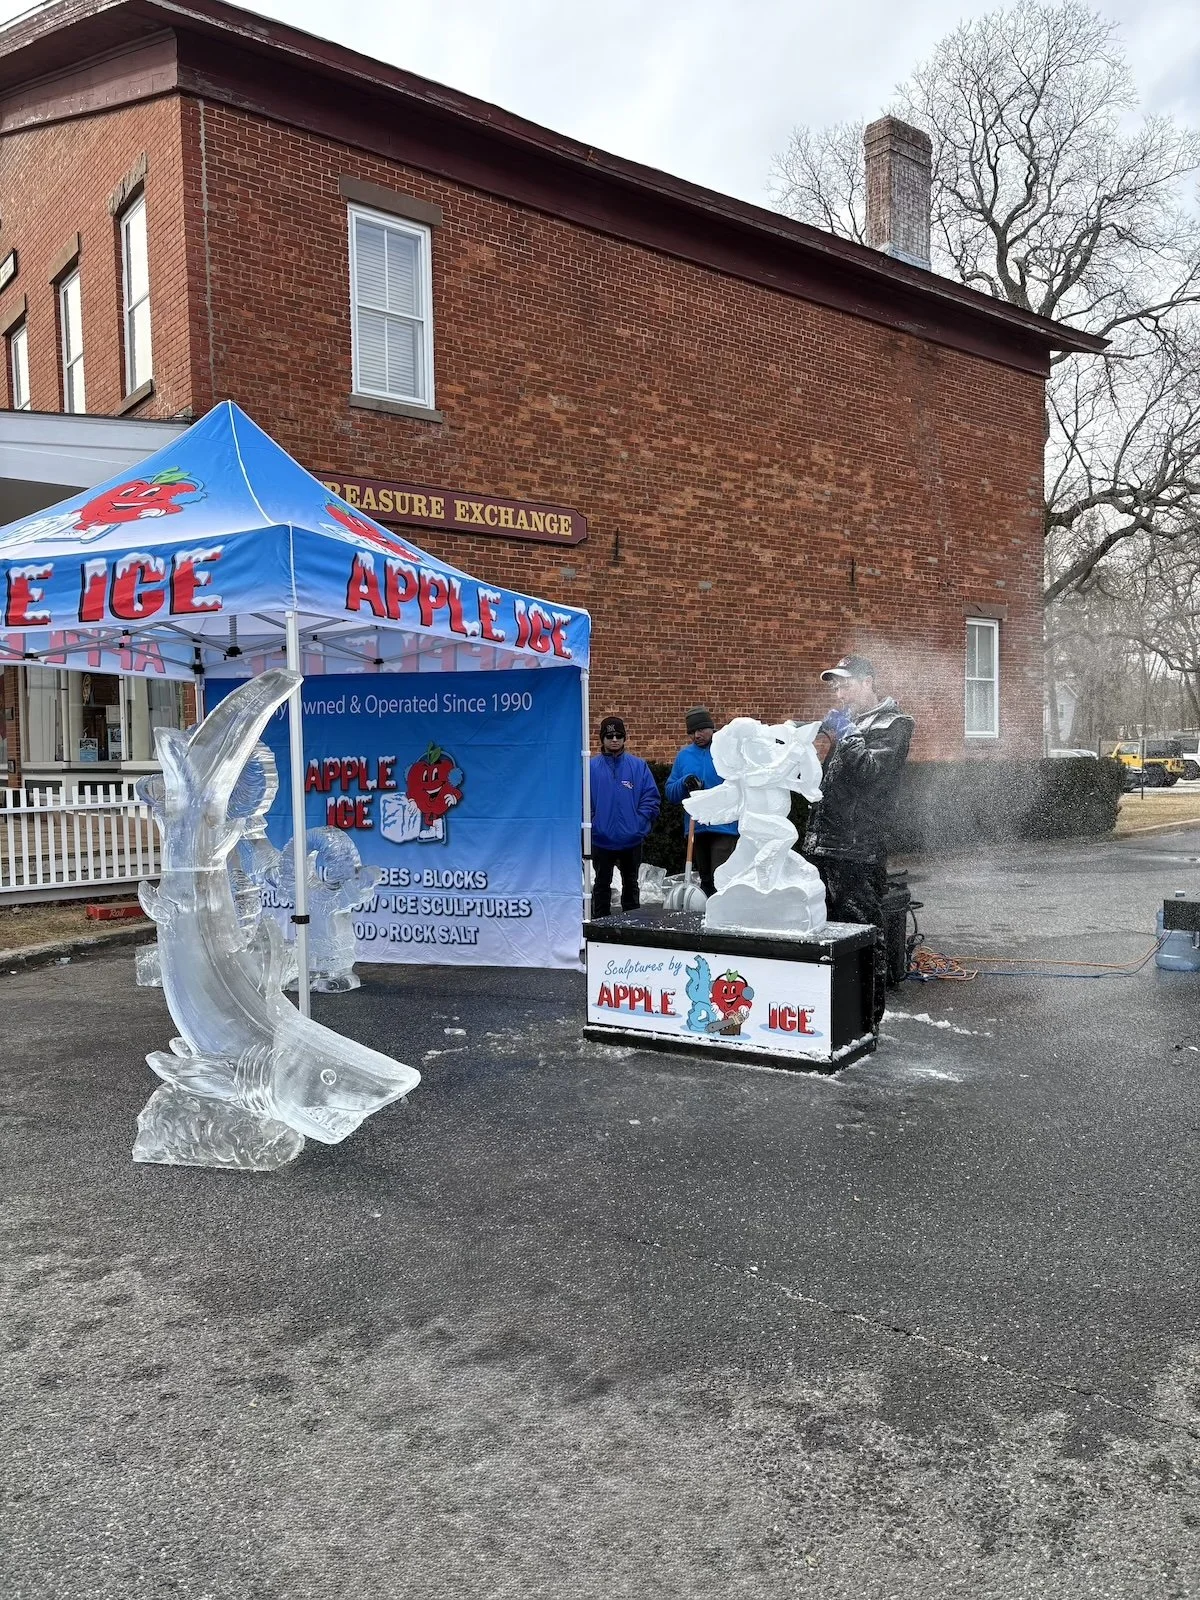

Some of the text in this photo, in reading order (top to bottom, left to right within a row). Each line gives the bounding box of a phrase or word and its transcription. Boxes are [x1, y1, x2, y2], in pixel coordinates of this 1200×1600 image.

[322, 480, 572, 536] REASURE EXCHANGE
[78, 545, 225, 622] ICE
[345, 551, 572, 659] APPLE ICE
[301, 695, 345, 714] wned
[350, 695, 361, 714] &
[365, 694, 438, 718] Operated
[443, 694, 486, 713] Since
[492, 692, 533, 711] 1990
[304, 756, 397, 793] APPLE
[326, 795, 374, 829] ICE
[379, 868, 411, 886] BES
[423, 869, 488, 890] BLOCKS
[391, 896, 418, 914] ICE
[420, 897, 532, 918] SCULPTURES
[389, 923, 436, 943] ROCK
[438, 925, 479, 945] SALT
[604, 956, 683, 980] Sculptures by
[597, 981, 816, 1035] APPLE ICE
